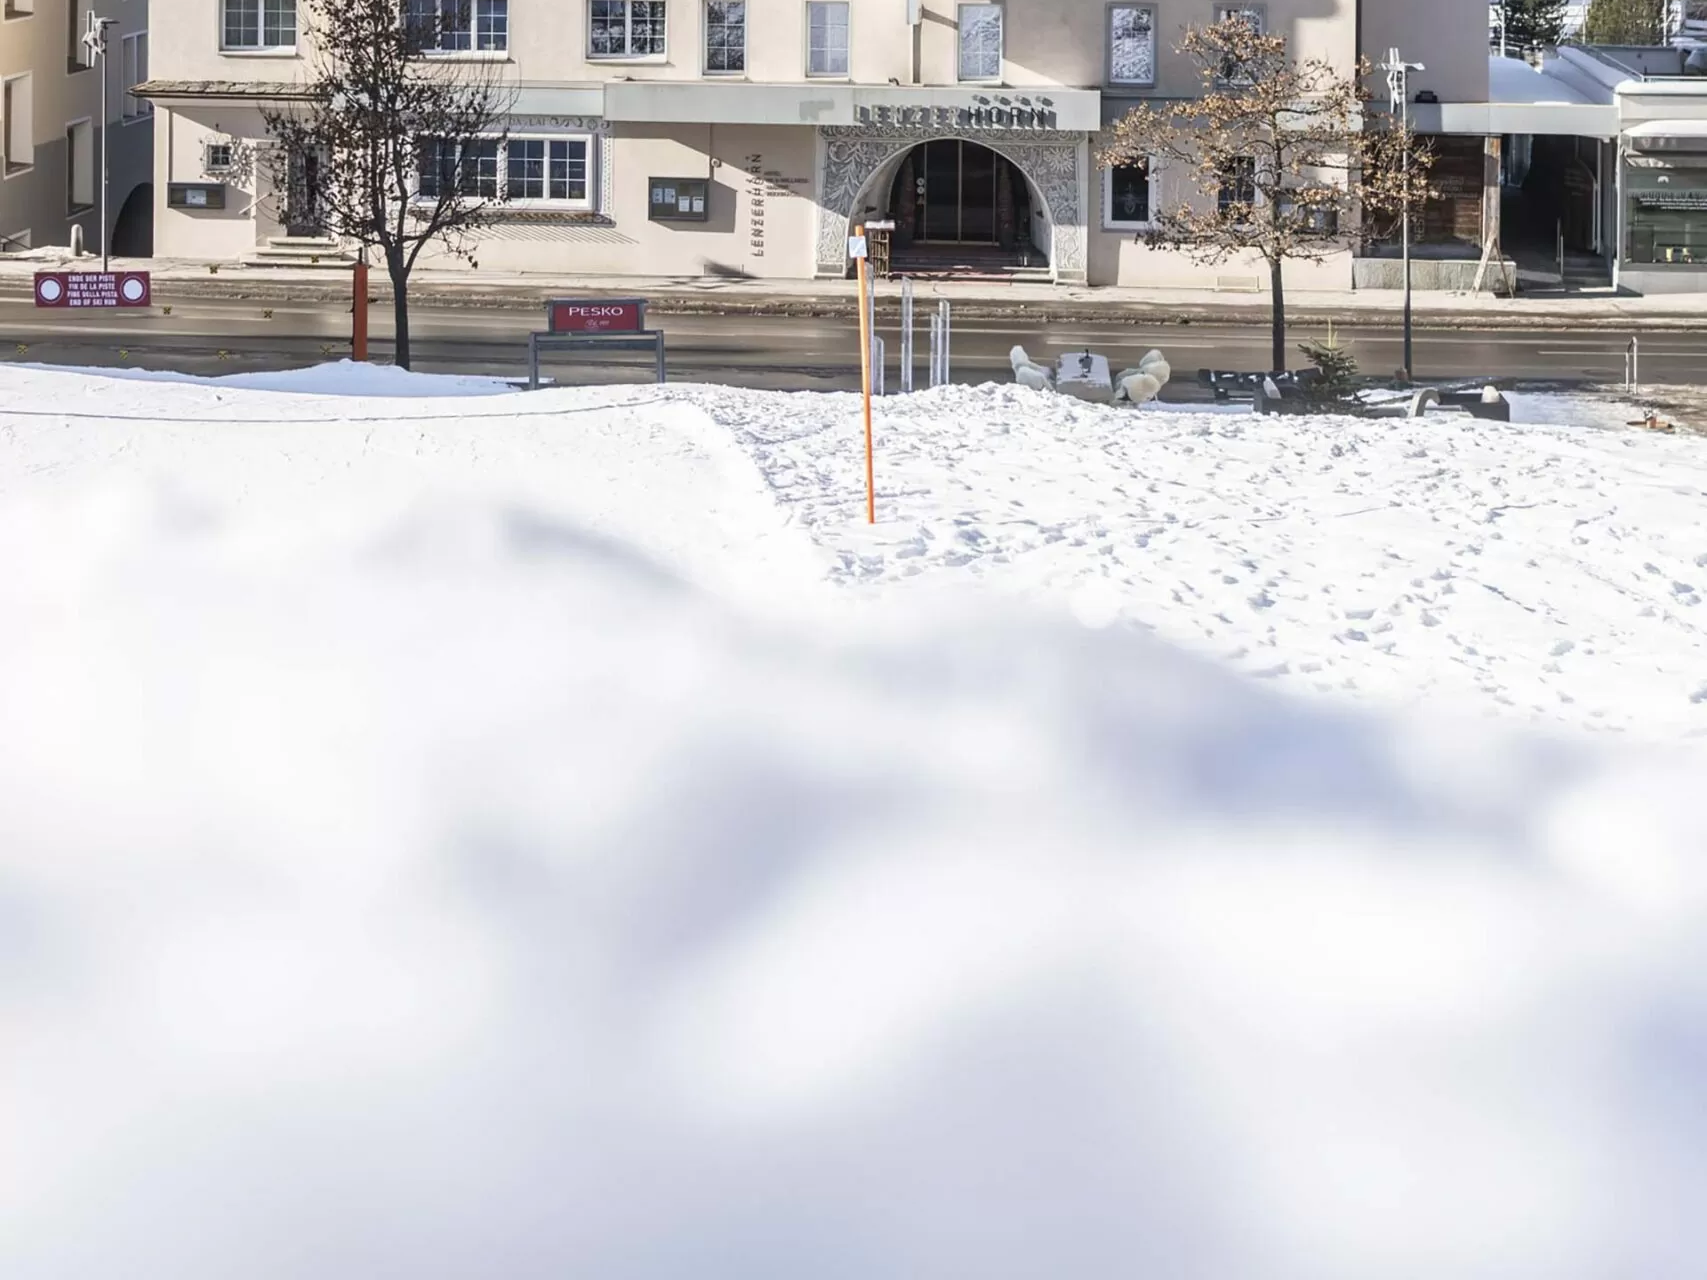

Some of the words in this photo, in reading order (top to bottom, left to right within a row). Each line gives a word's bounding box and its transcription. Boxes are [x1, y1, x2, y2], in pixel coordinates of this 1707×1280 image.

[853, 103, 1046, 125] LENZERHORN
[751, 154, 764, 257] LENZERHORN
[568, 306, 624, 317] PESKO
